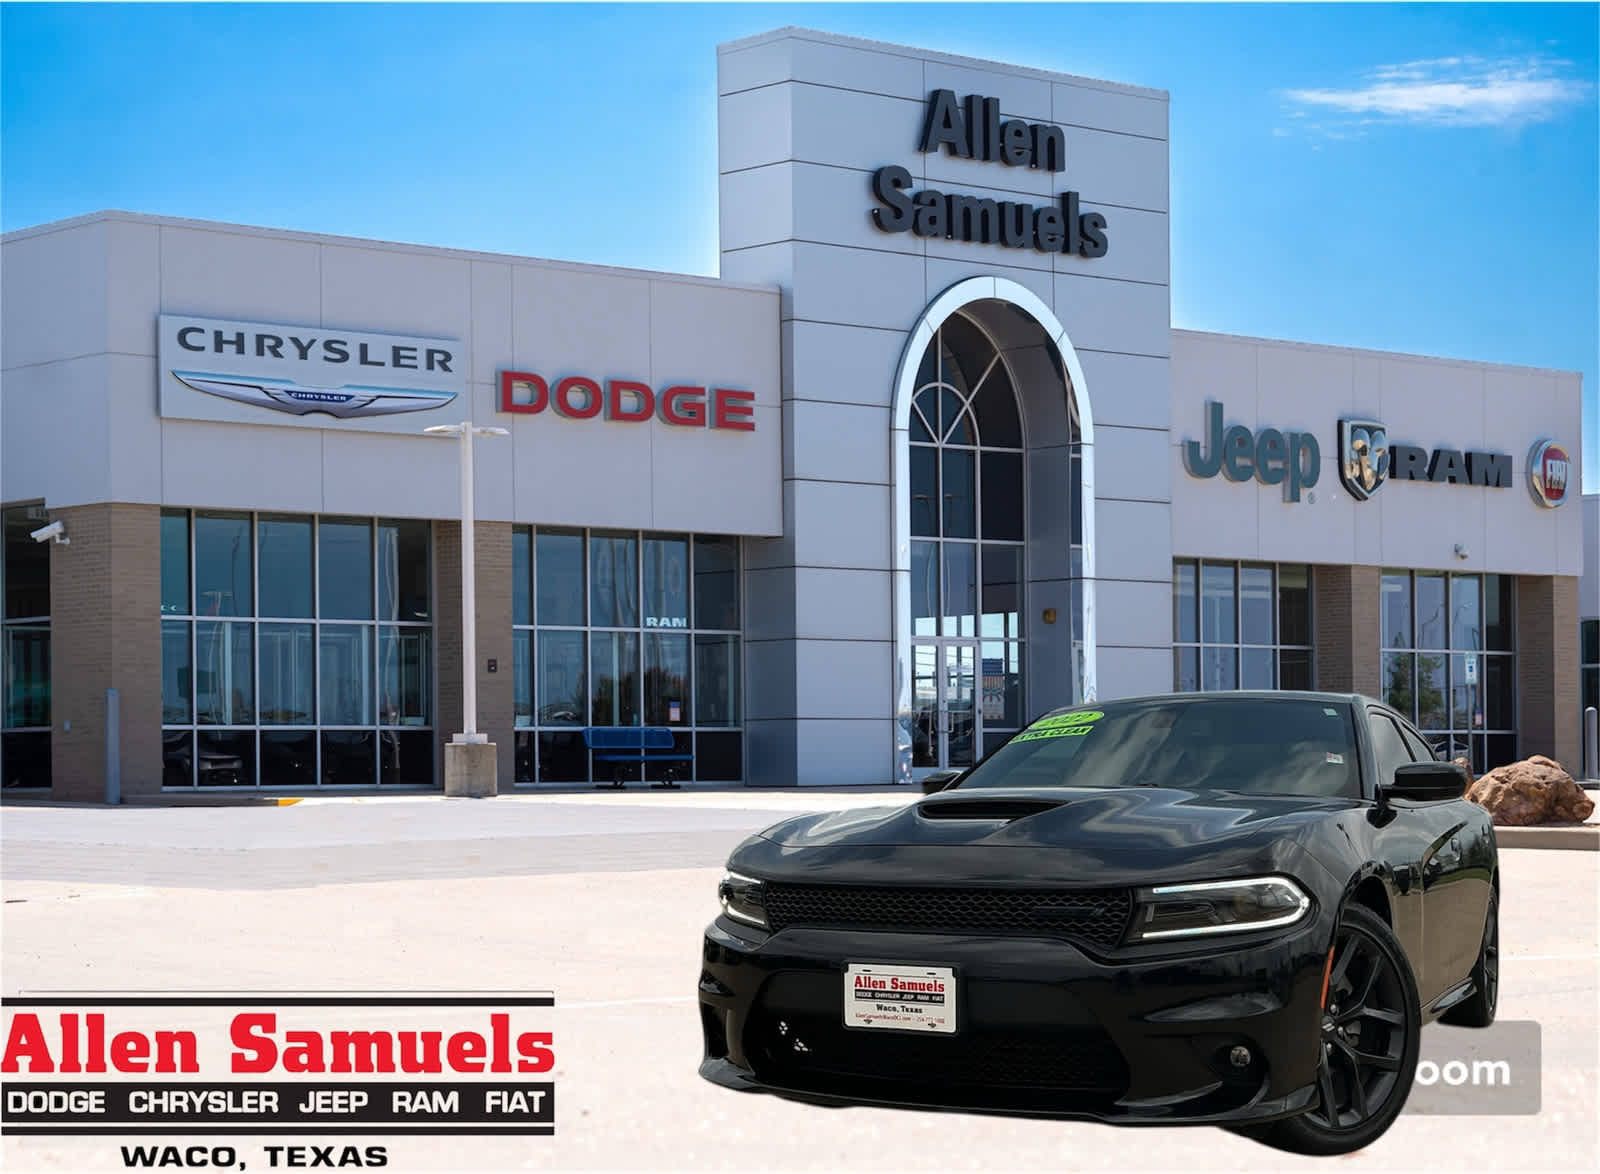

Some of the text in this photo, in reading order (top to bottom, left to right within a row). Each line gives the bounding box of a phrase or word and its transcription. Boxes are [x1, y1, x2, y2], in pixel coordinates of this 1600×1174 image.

[918, 88, 1065, 172] Allen
[872, 165, 1108, 257] Samuels
[177, 326, 453, 373] CHRYSLER
[290, 392, 347, 402] CHRYSLER
[495, 370, 755, 432] DODGE
[1182, 400, 1321, 503] Jeep
[1389, 444, 1513, 489] RAM
[1545, 458, 1568, 490] FIAT
[645, 616, 688, 628] RAM
[854, 975, 945, 992] Allen Samuels
